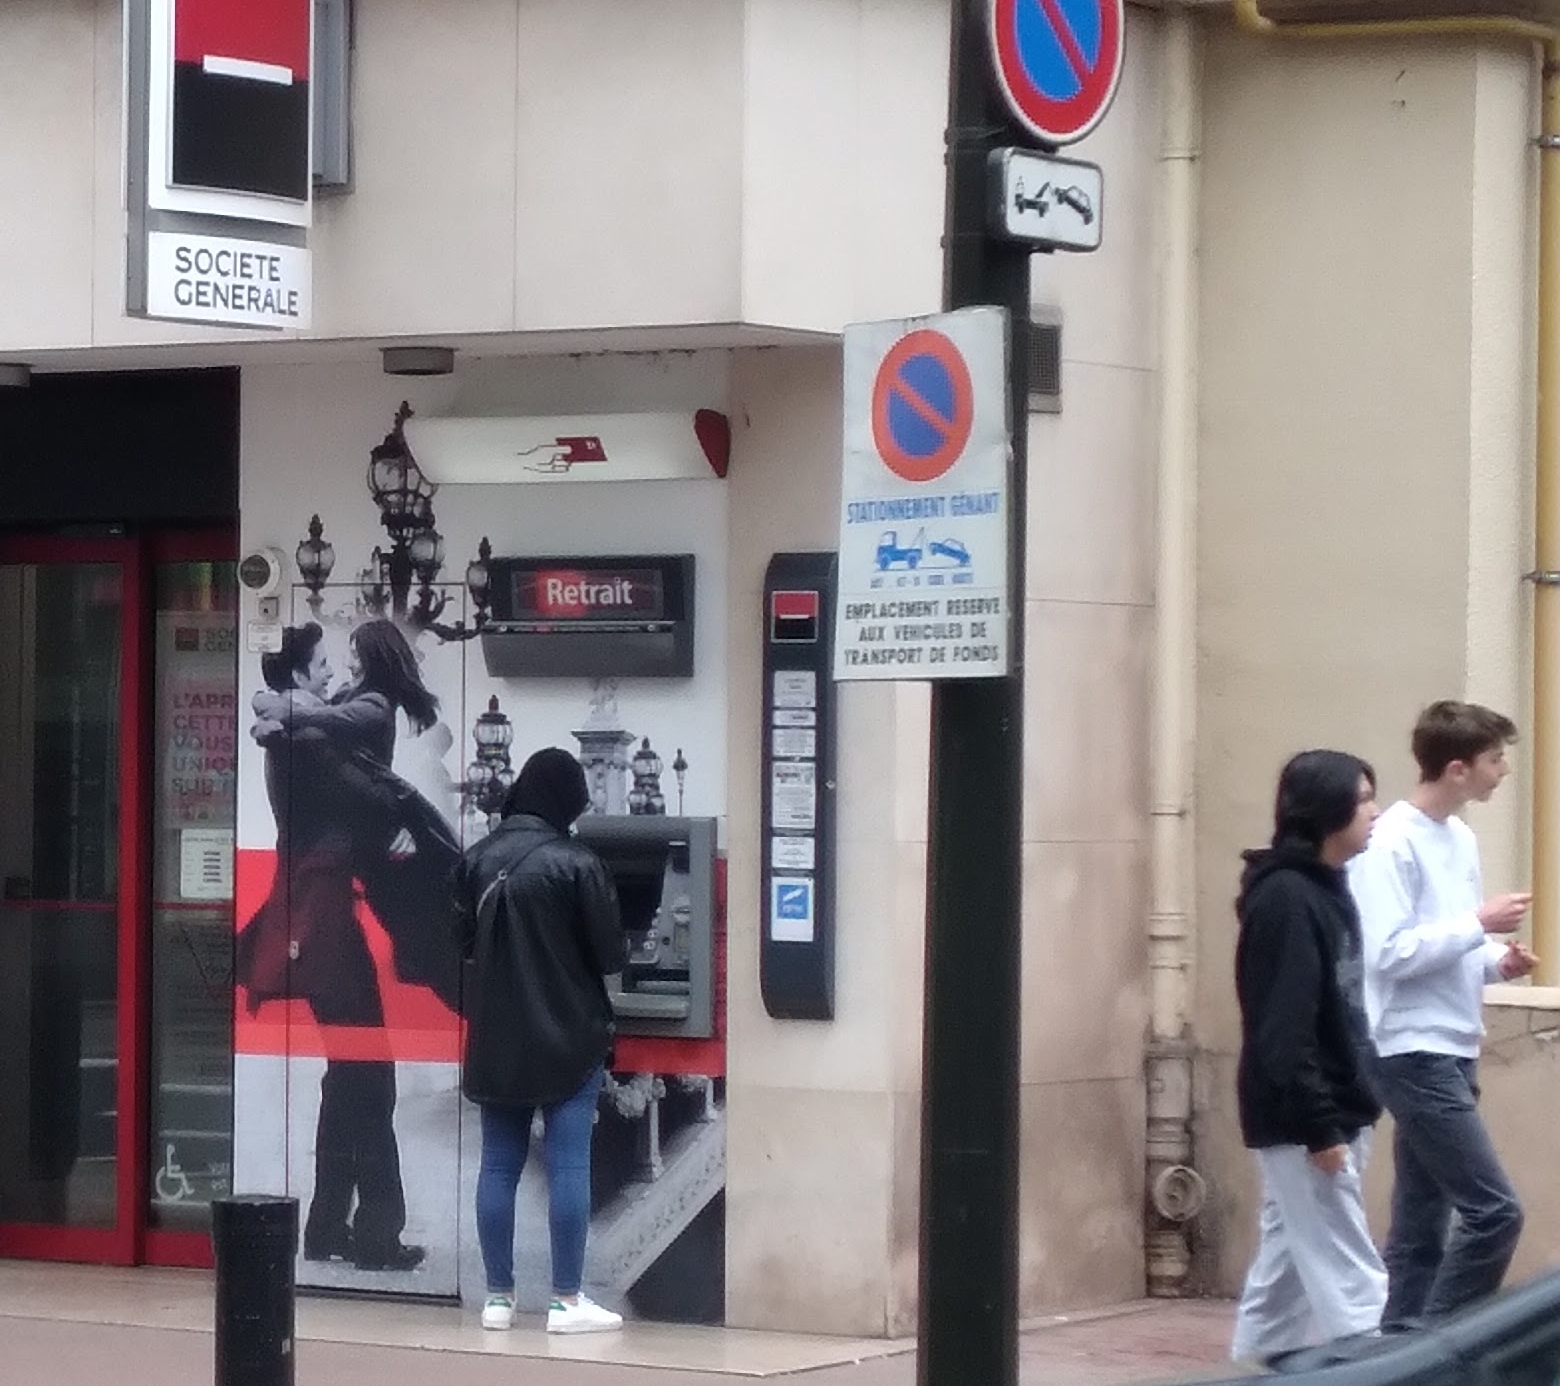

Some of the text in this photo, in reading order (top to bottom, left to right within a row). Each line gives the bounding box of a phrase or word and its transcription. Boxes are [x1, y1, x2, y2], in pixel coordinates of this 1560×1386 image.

[174, 246, 281, 283] SOCIETE
[173, 278, 299, 317] GENERALE
[847, 496, 945, 524] STATIONNEMENT
[546, 577, 633, 605] Retrait
[845, 600, 939, 620] EMPLACEMENT
[859, 621, 986, 641] AUX VEHICULES DE
[844, 645, 1000, 665] TRANSPORT DE FONDS
